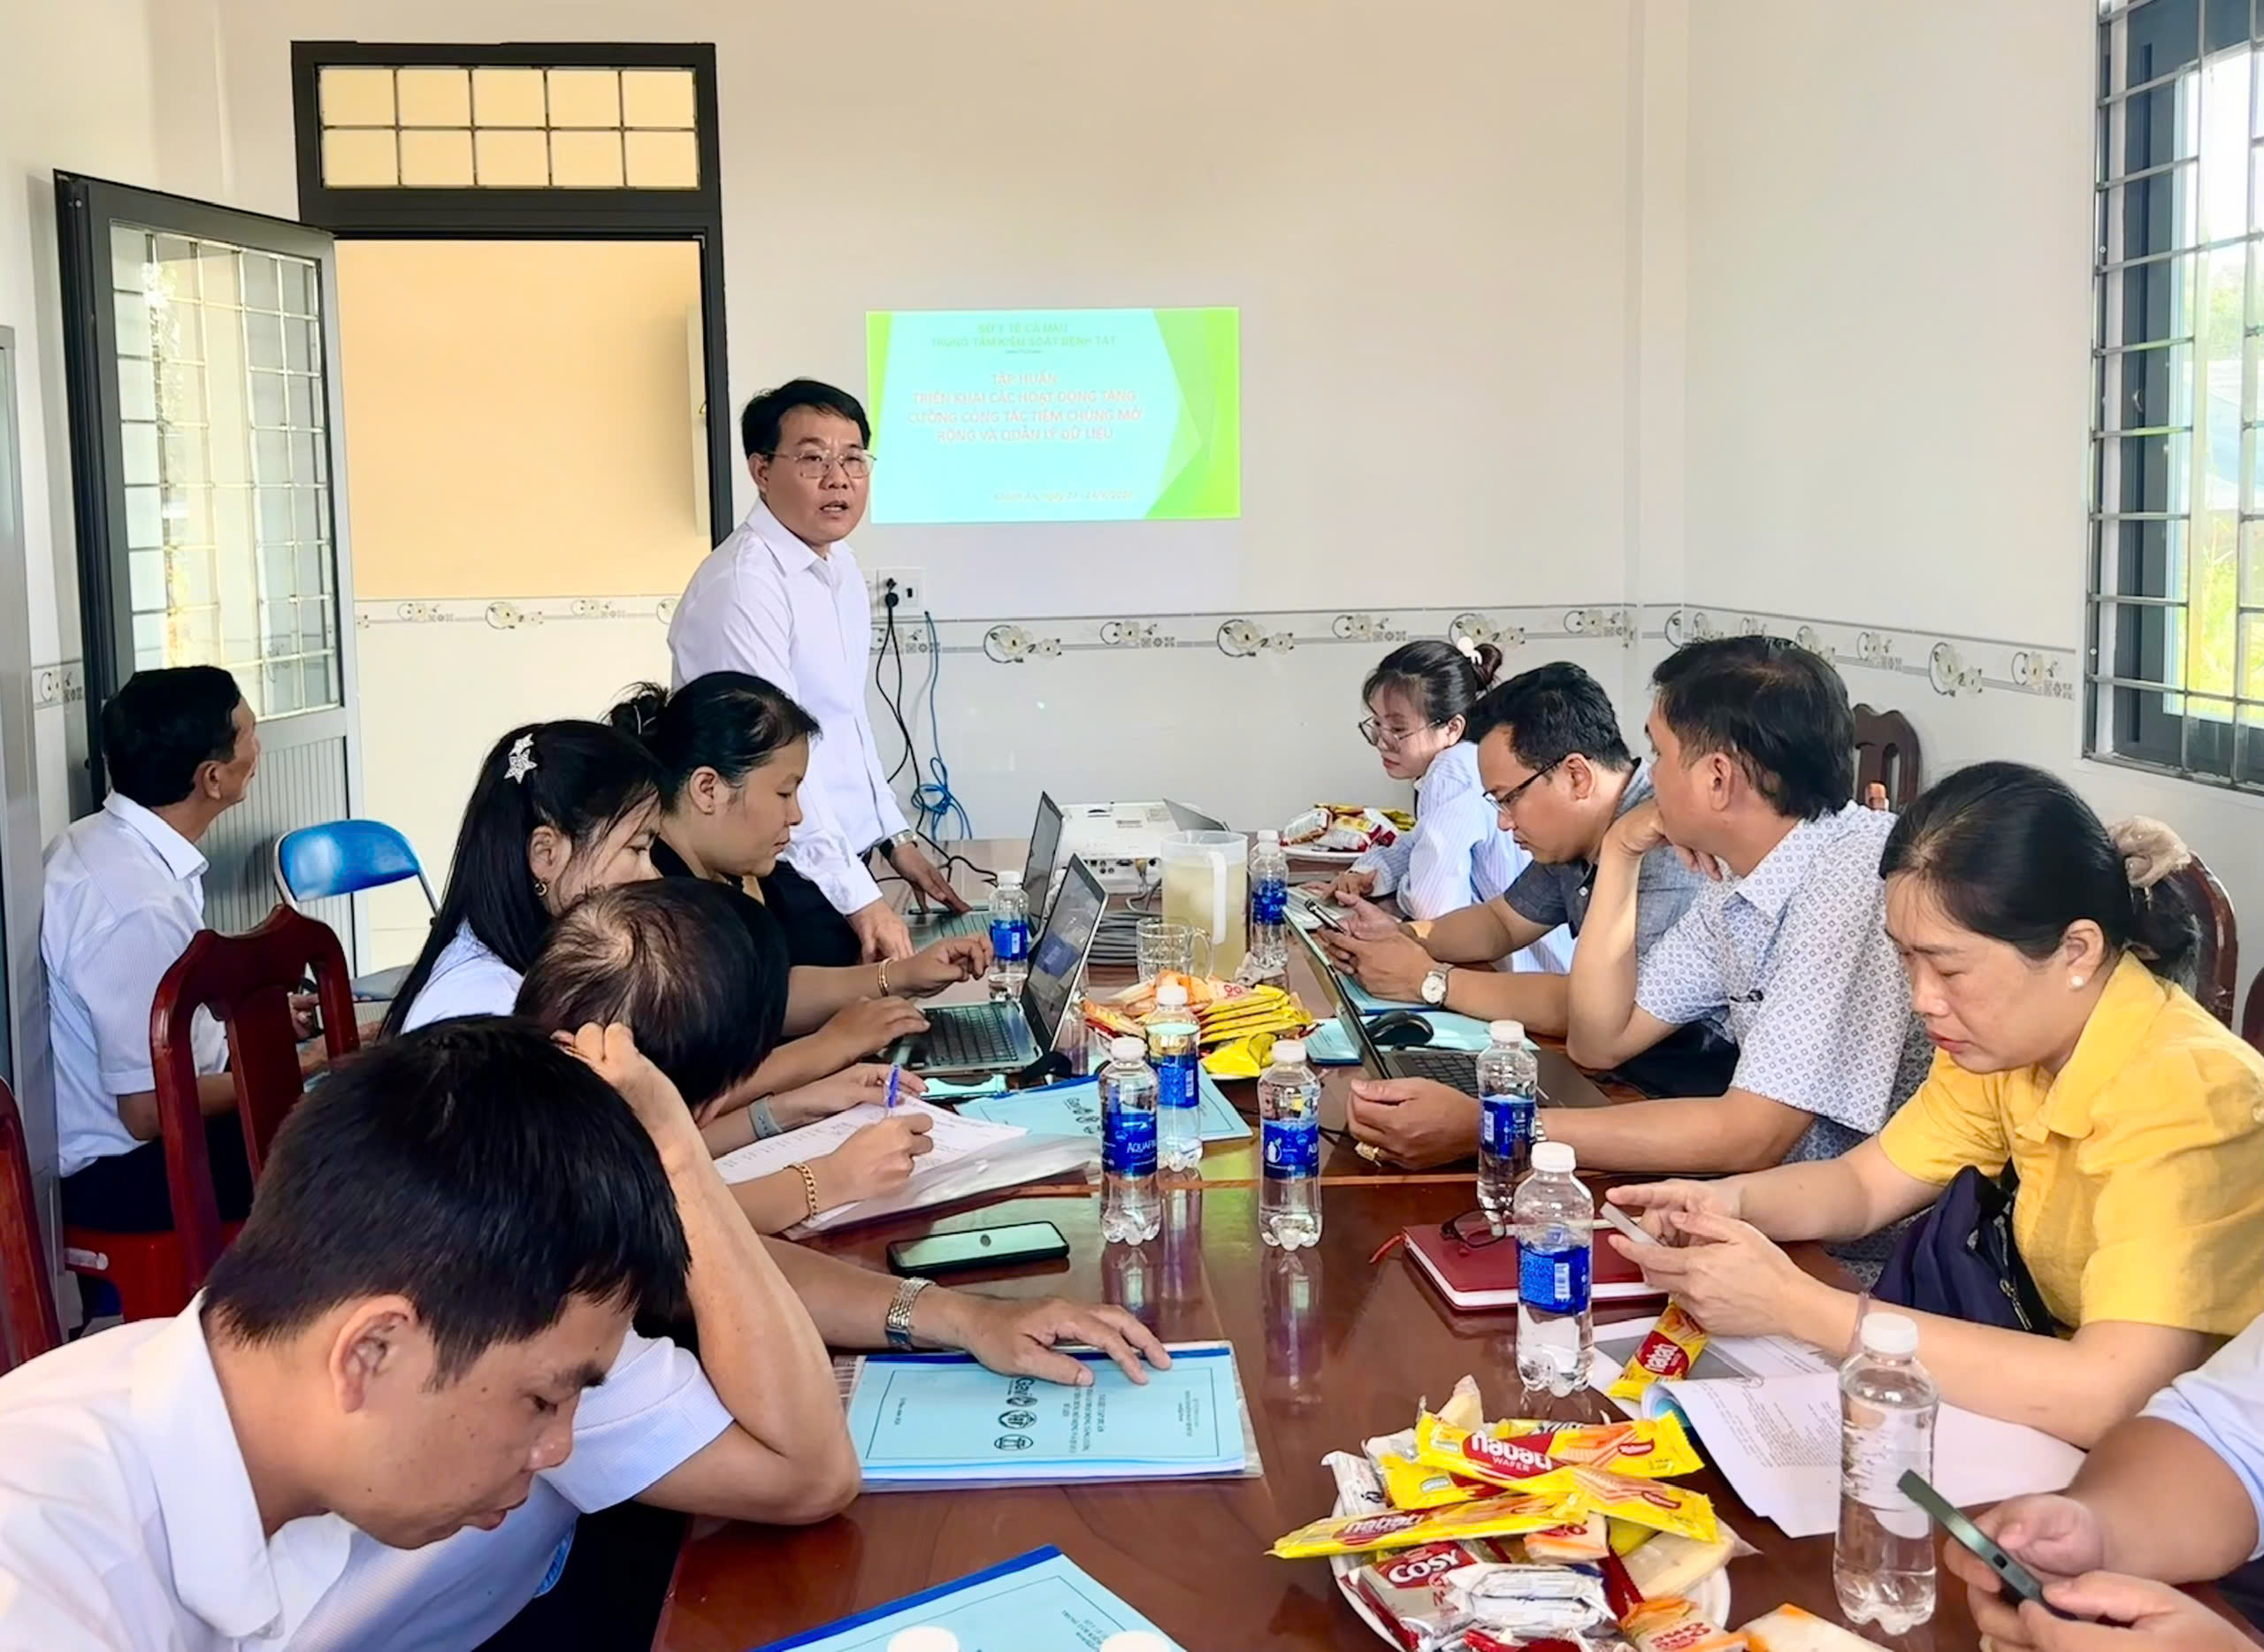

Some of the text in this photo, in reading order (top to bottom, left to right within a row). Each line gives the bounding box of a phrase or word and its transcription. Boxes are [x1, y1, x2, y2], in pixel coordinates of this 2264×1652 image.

[954, 390, 986, 404] KHAI
[1492, 1456, 1531, 1472] WAFER
[1388, 1549, 1460, 1583] COSY
